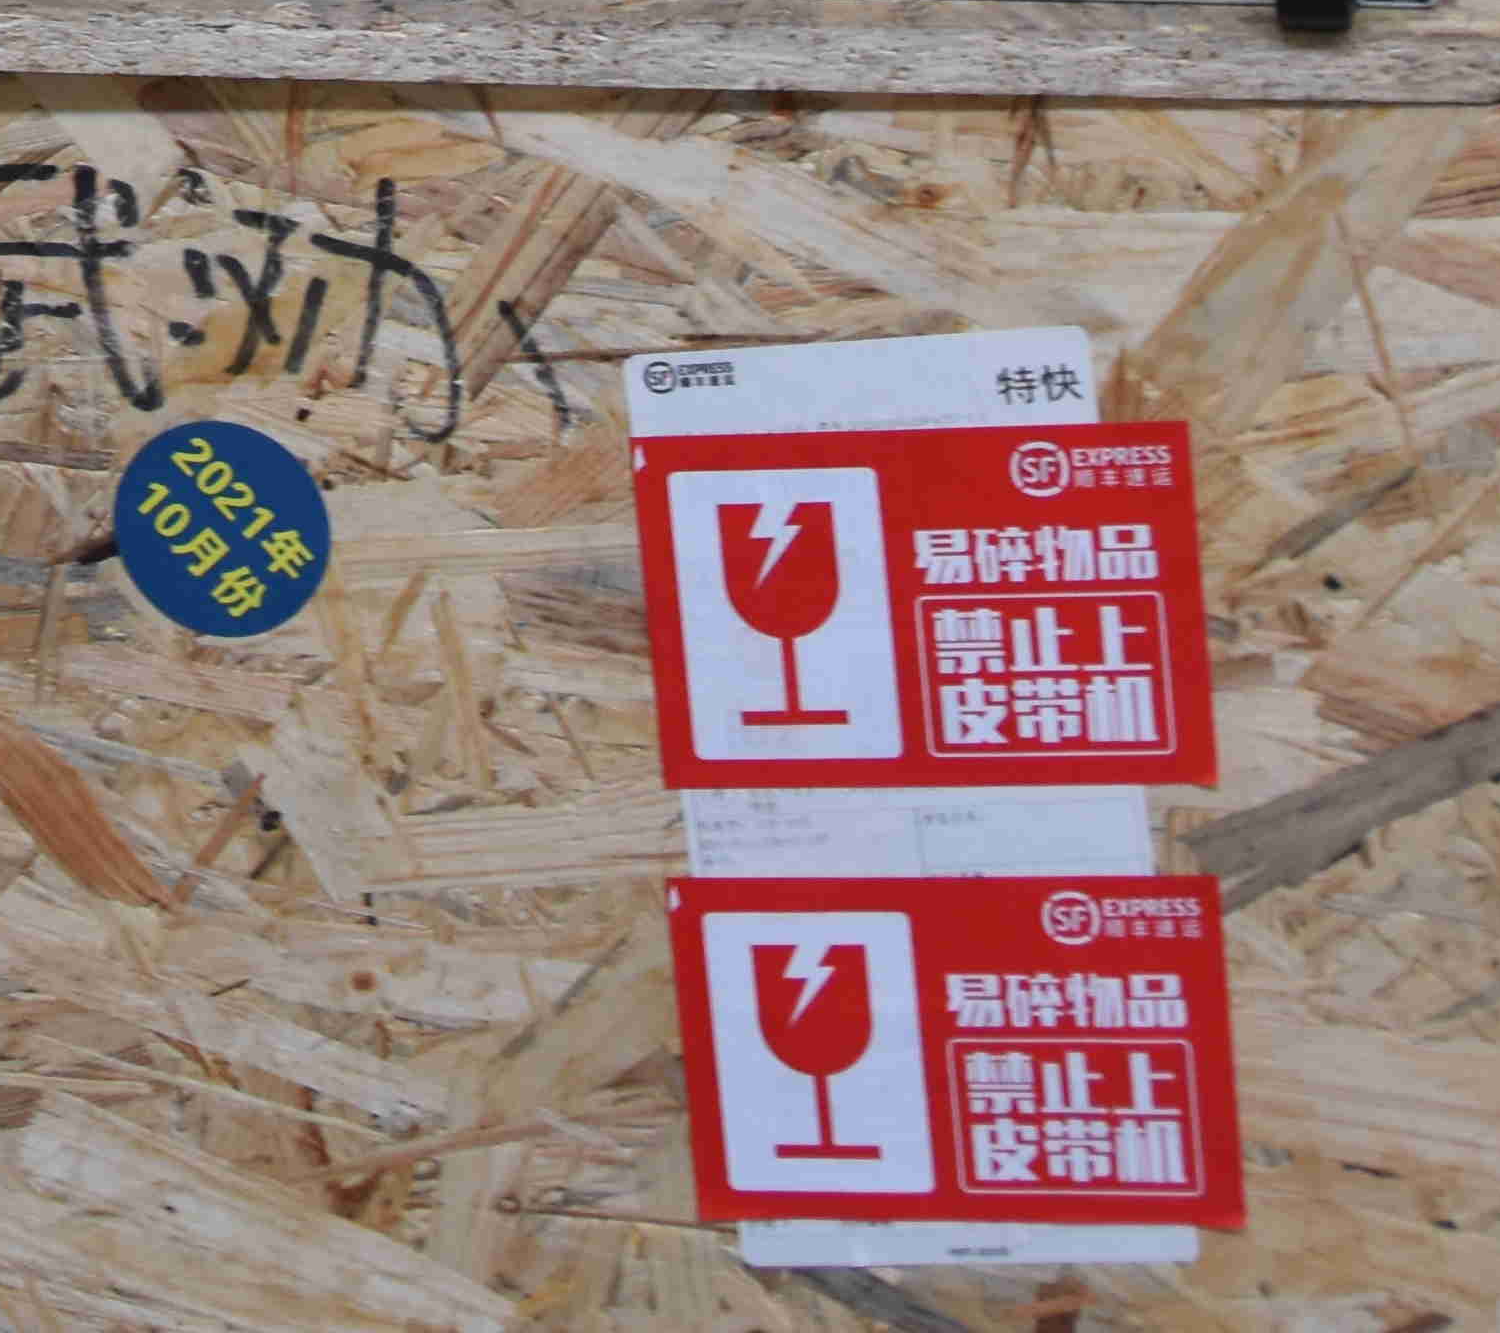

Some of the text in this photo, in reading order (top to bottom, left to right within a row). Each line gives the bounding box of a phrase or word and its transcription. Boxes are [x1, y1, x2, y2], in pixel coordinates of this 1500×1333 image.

[996, 363, 1085, 406] 特快
[1070, 445, 1173, 467] EXPRESS
[168, 436, 316, 580] 2021年
[136, 481, 268, 618] 10月份
[912, 524, 1160, 585] 易碎物品
[931, 604, 1155, 675] 禁止上
[938, 675, 1161, 745] 皮带机
[1101, 897, 1202, 918] EXPRESS
[945, 972, 1189, 1029] 易碎物品
[964, 1051, 1183, 1116] 禁止上
[969, 1118, 1189, 1183] 皮带机
